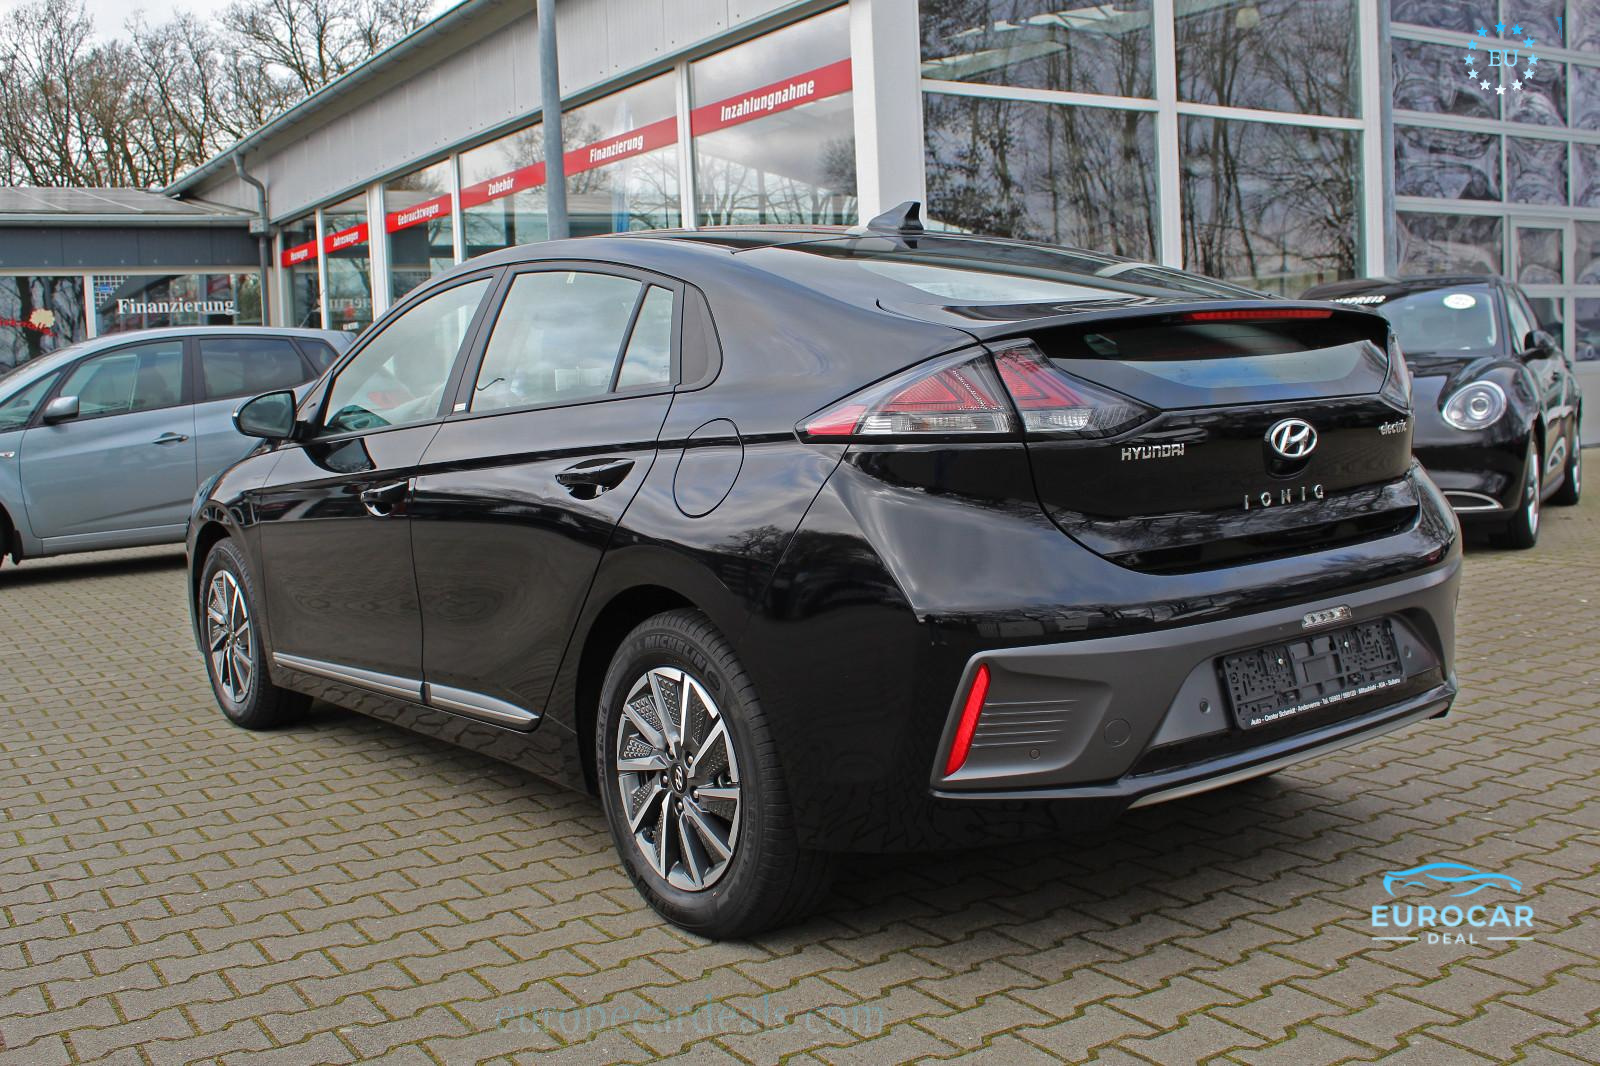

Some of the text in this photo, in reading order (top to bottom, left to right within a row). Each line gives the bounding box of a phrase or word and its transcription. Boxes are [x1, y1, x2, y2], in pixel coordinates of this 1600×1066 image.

[720, 79, 815, 122] Inzahlungnahme
[589, 134, 643, 163] Finanzierung
[487, 176, 514, 196] Zubehör
[398, 203, 439, 226] Gebrauchtwagen
[117, 298, 235, 315] Finanzierung
[1379, 420, 1407, 436] electric
[1121, 443, 1185, 461] HYUNDAI
[1243, 484, 1324, 510] IONIQ
[644, 634, 708, 673] MICHELIN
